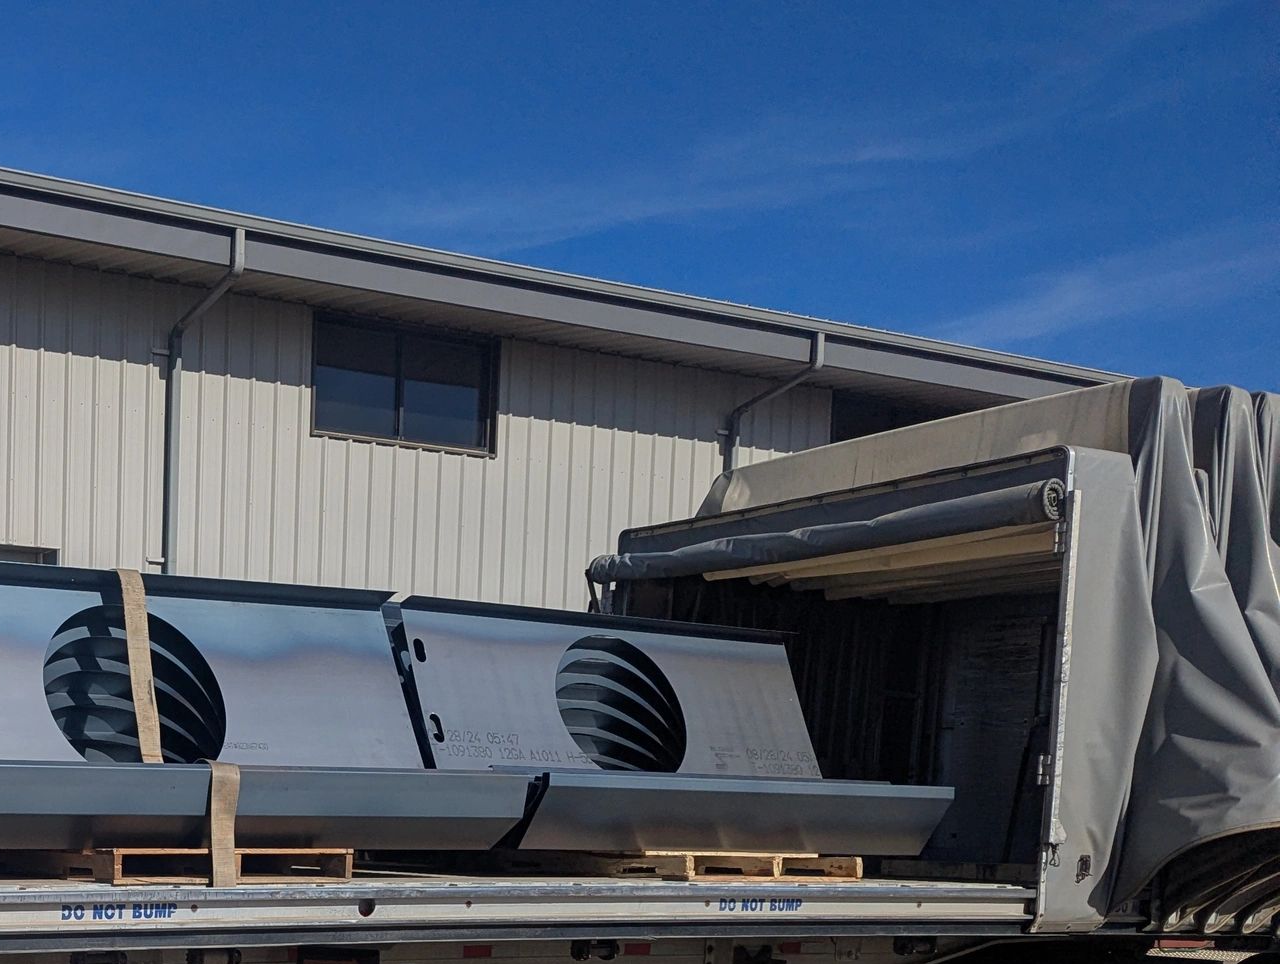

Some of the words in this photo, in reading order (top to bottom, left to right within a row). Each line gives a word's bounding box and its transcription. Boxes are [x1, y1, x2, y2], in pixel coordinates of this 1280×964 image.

[486, 731, 520, 745] 05:47
[499, 747, 526, 760] 12GA
[530, 750, 562, 763] A1011
[61, 904, 85, 920] DO
[93, 904, 126, 920] NOT
[132, 903, 178, 919] BUMP
[719, 898, 736, 911] DO
[741, 898, 766, 911] NOT
[769, 898, 802, 911] BUMP
